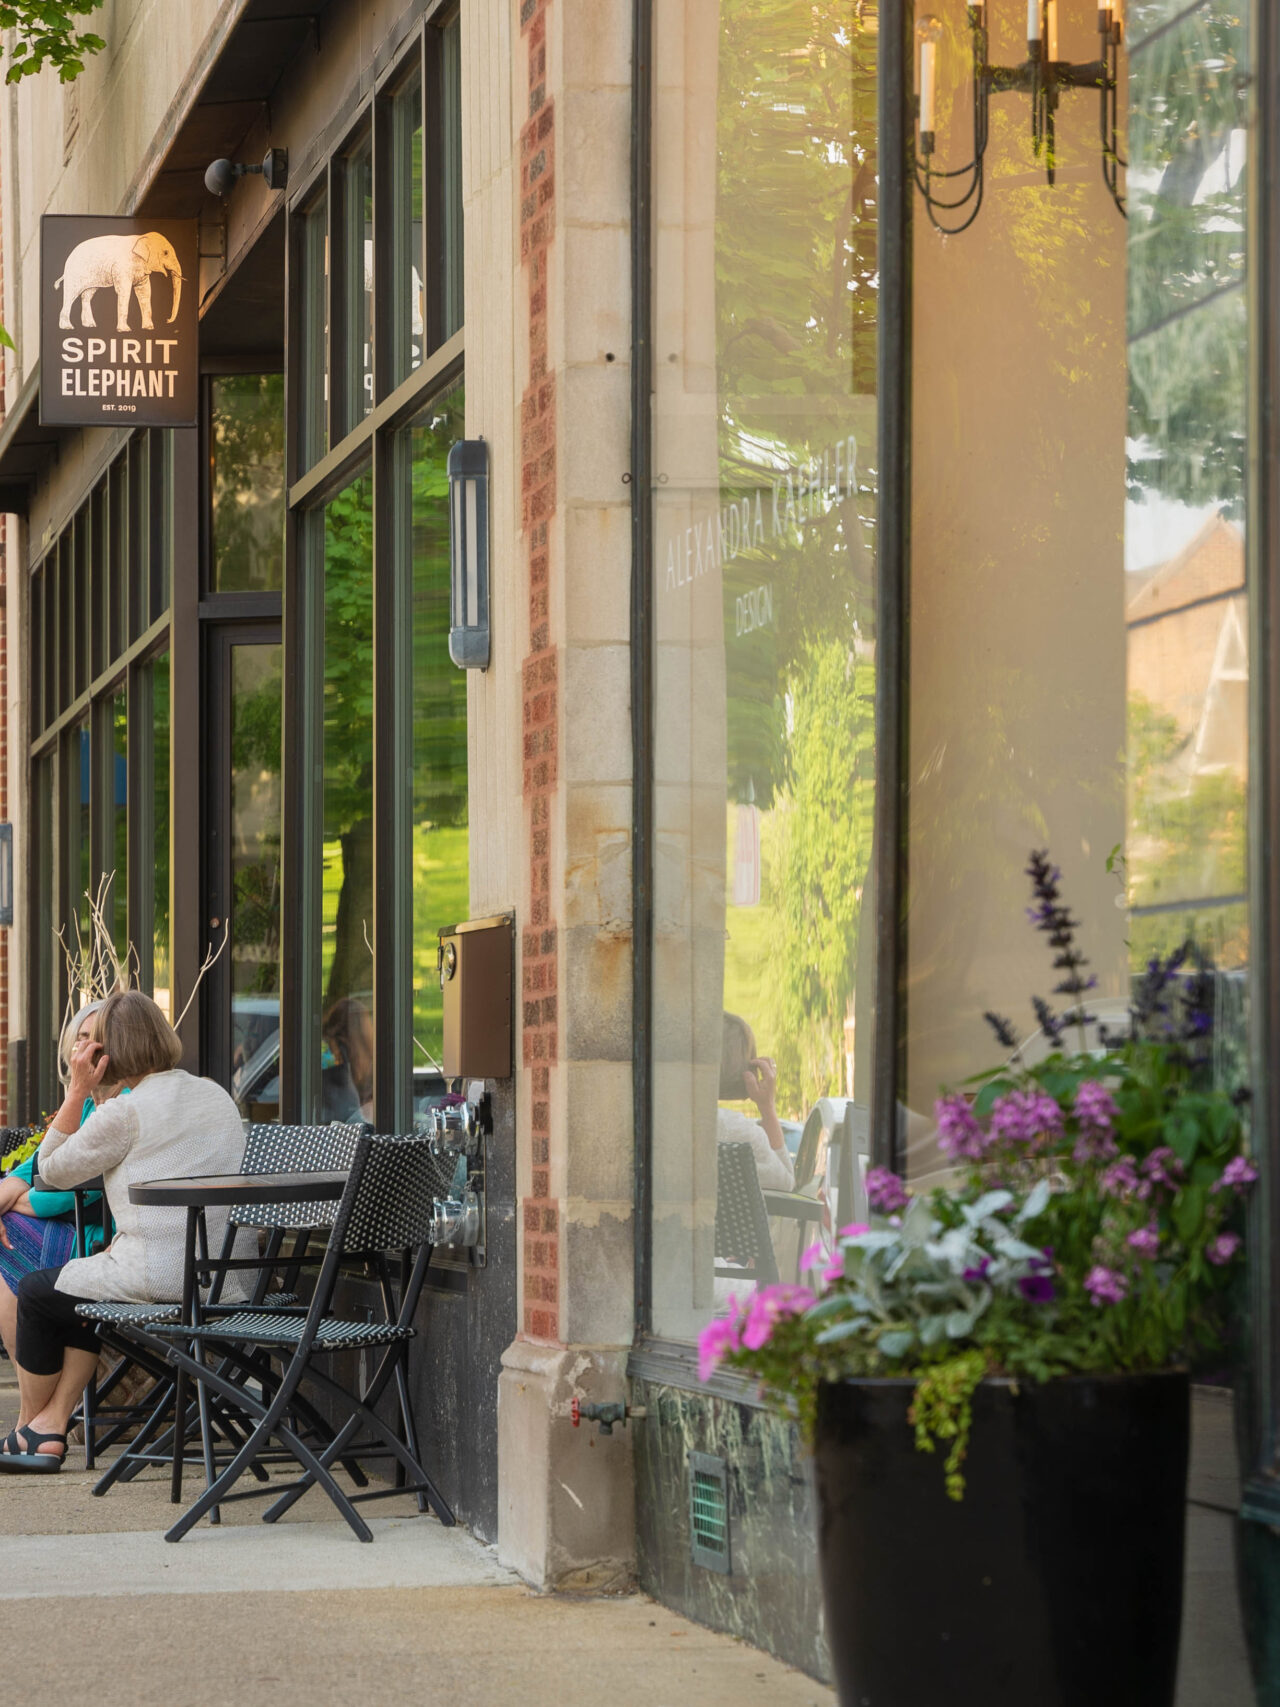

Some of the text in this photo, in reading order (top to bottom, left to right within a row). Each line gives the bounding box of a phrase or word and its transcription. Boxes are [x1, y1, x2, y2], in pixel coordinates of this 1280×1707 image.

[61, 337, 178, 364] SPIRIT
[61, 368, 179, 398] ELEPHANT
[118, 404, 137, 412] 2019
[665, 488, 765, 593] ALEXANDRA
[735, 582, 773, 638] DESIGN
